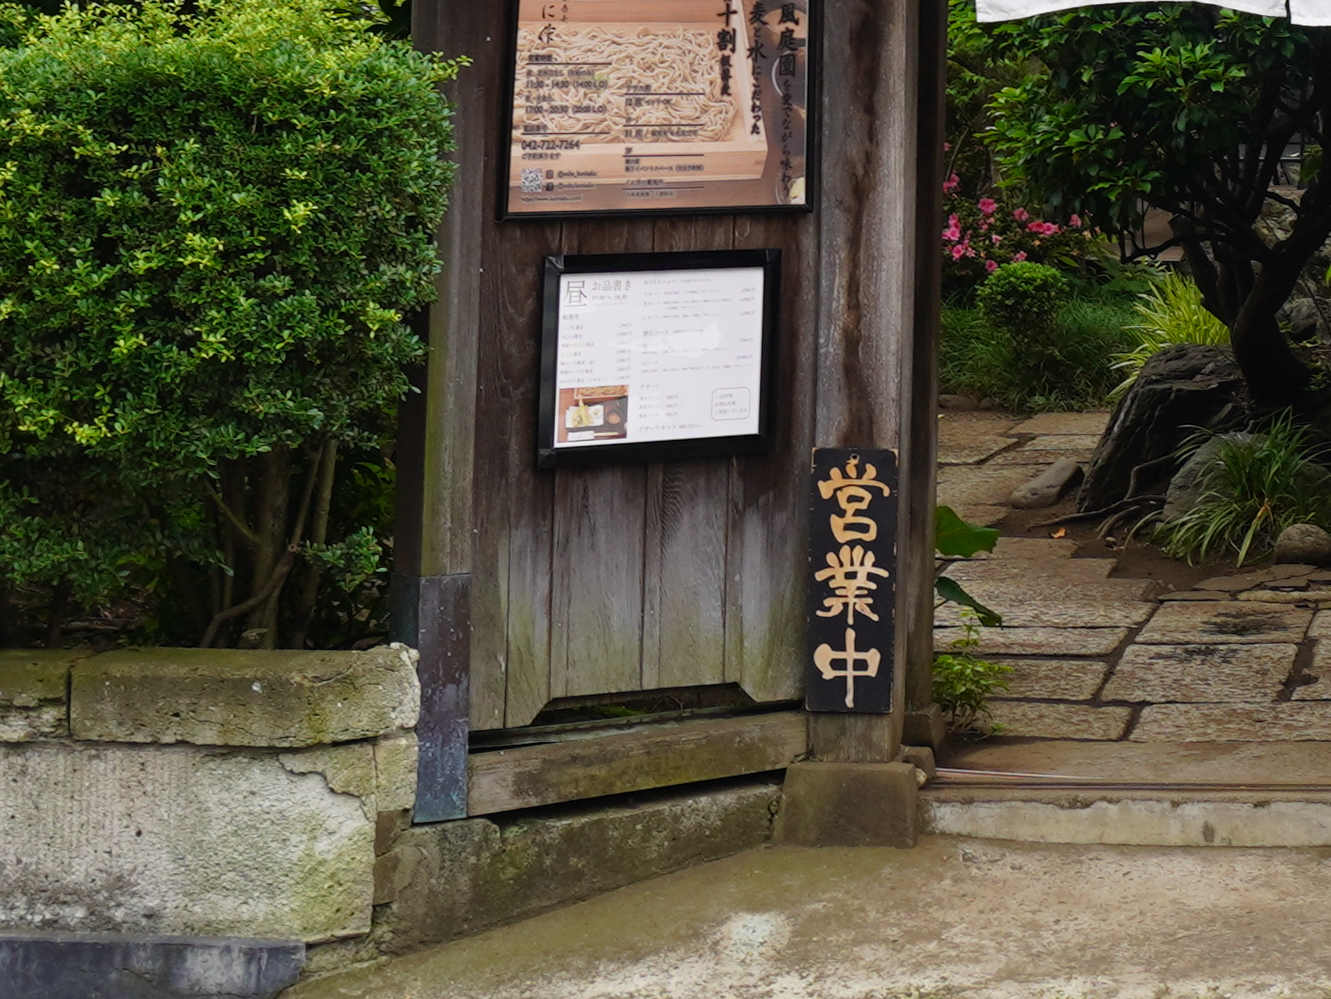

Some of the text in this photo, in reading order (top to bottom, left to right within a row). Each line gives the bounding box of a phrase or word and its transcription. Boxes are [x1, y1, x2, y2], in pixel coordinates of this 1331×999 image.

[521, 140, 580, 151] 042-722-7264
[563, 280, 588, 308] 昼
[813, 460, 891, 708] 営業中
